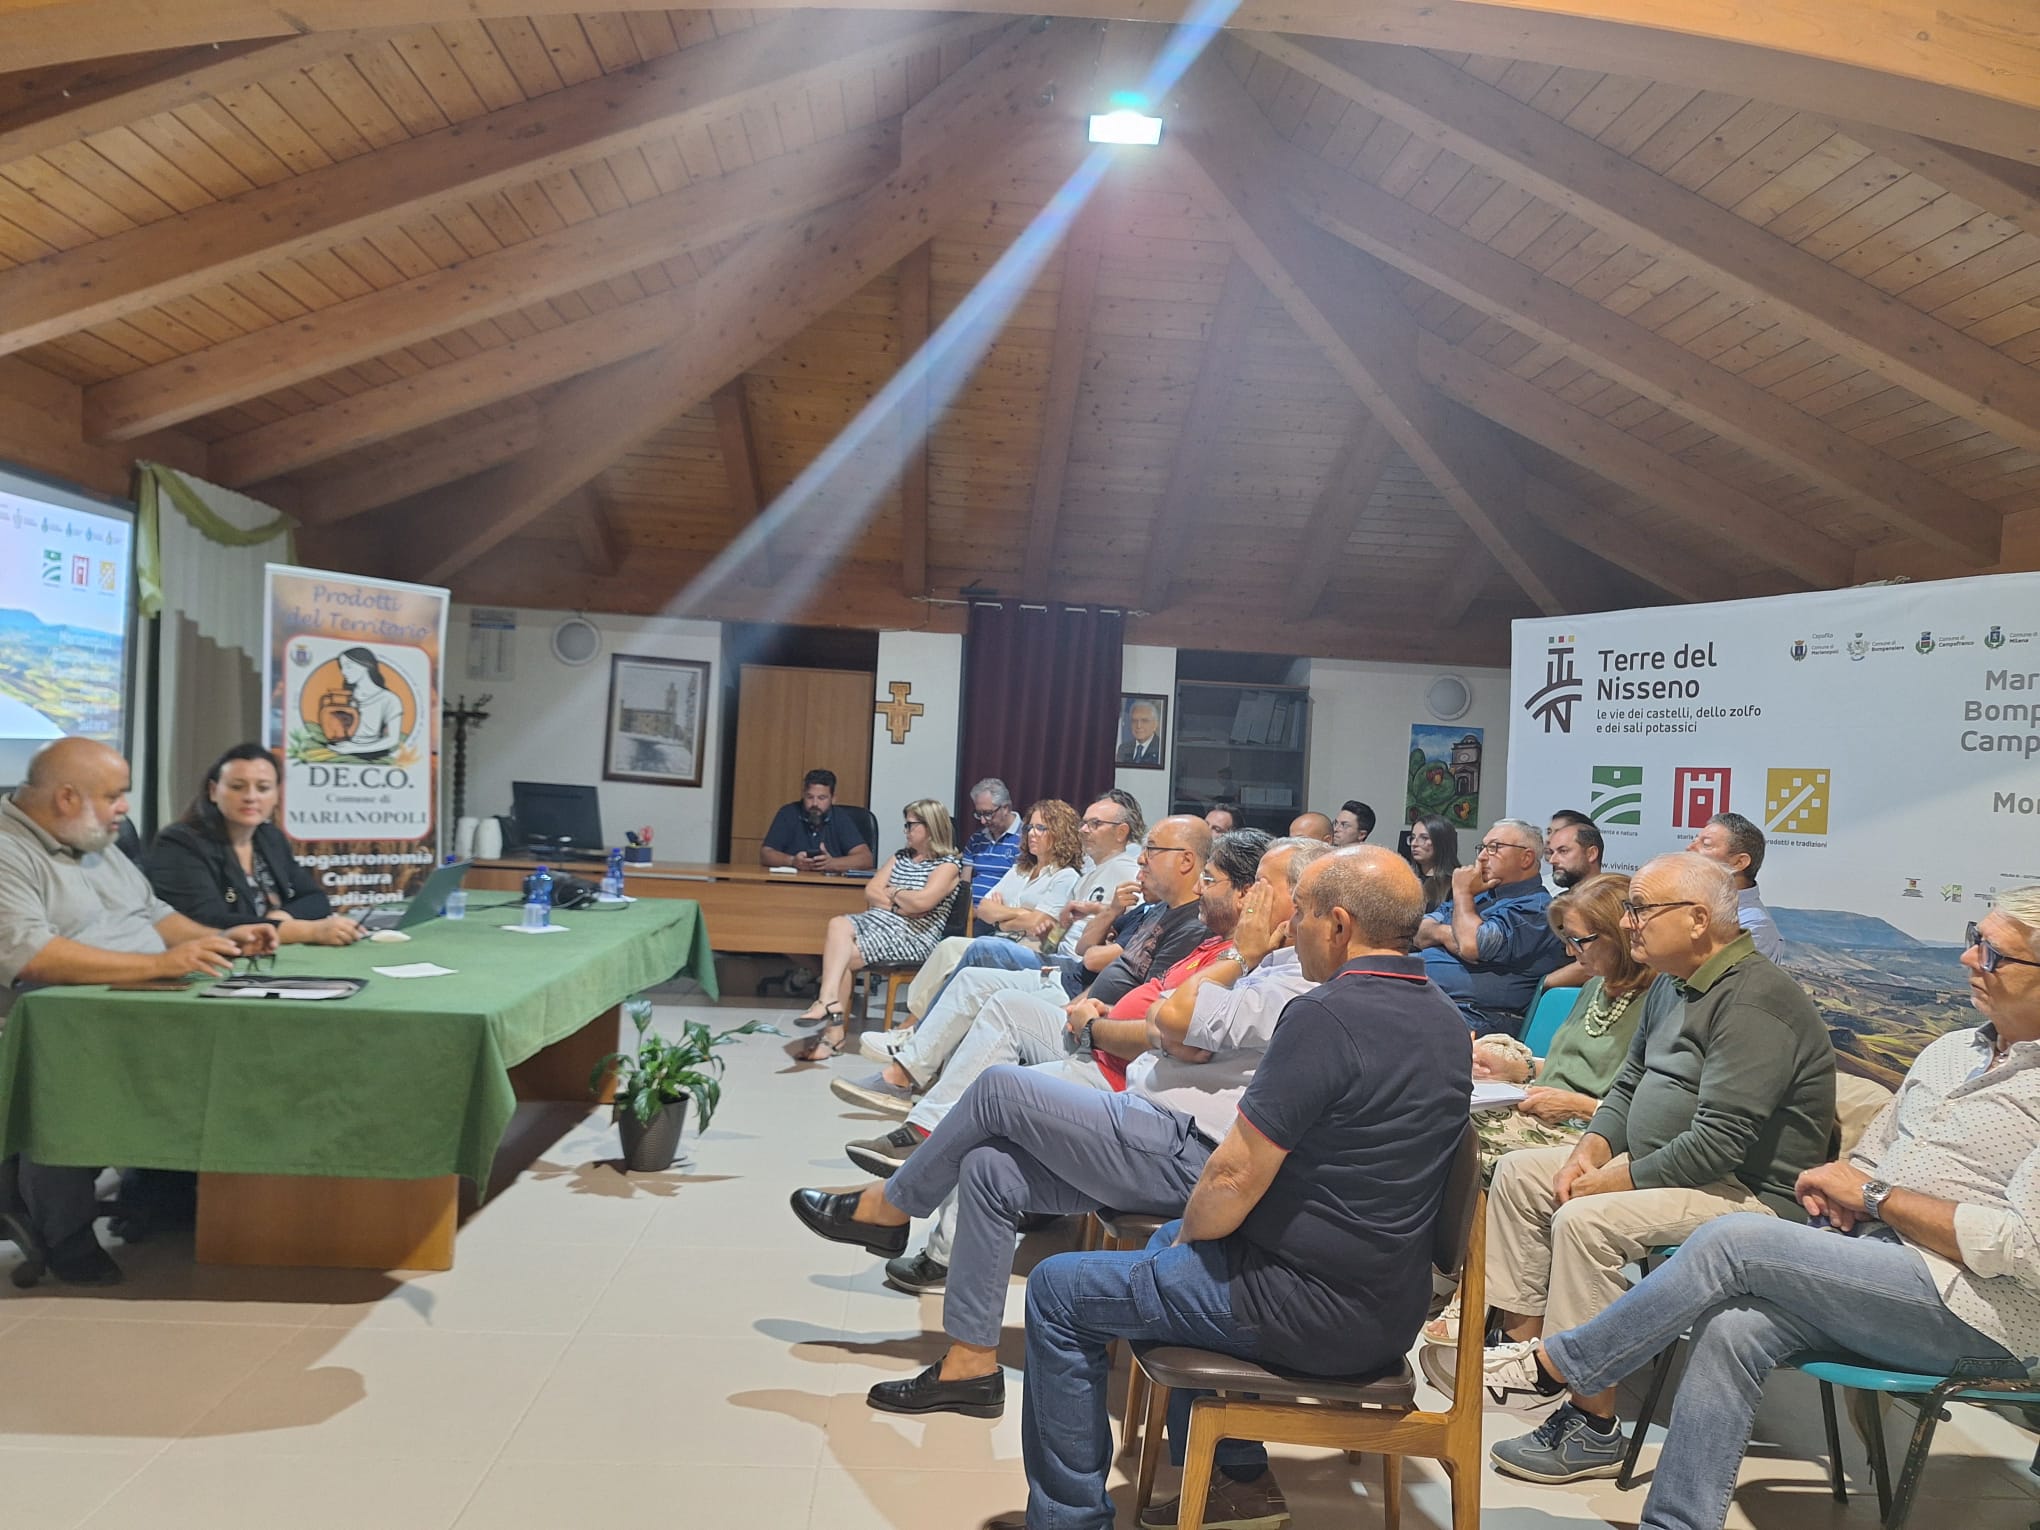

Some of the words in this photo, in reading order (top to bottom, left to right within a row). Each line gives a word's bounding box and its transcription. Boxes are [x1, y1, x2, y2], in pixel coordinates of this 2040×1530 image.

[313, 584, 402, 612] Prodotti
[284, 606, 322, 628] del
[329, 612, 431, 639] Territorio
[1598, 649, 1665, 672] Terre
[1673, 641, 1717, 669] del
[1597, 676, 1700, 701] Nisseno
[1597, 709, 1607, 719] le
[1609, 708, 1625, 719] vie
[1627, 707, 1644, 719] dei
[1646, 706, 1693, 720] castelli,
[1695, 705, 1727, 718] dello
[1729, 704, 1762, 718] zolfo
[1596, 724, 1603, 734] e
[1605, 722, 1621, 734] dei
[1623, 721, 1643, 734] sali
[1645, 721, 1697, 736] potassici
[308, 765, 414, 789] DE.C.O.
[326, 794, 375, 804] Comune
[379, 794, 391, 804] di
[288, 810, 426, 825] MARIANOPOLI
[322, 871, 393, 887] Cultura
